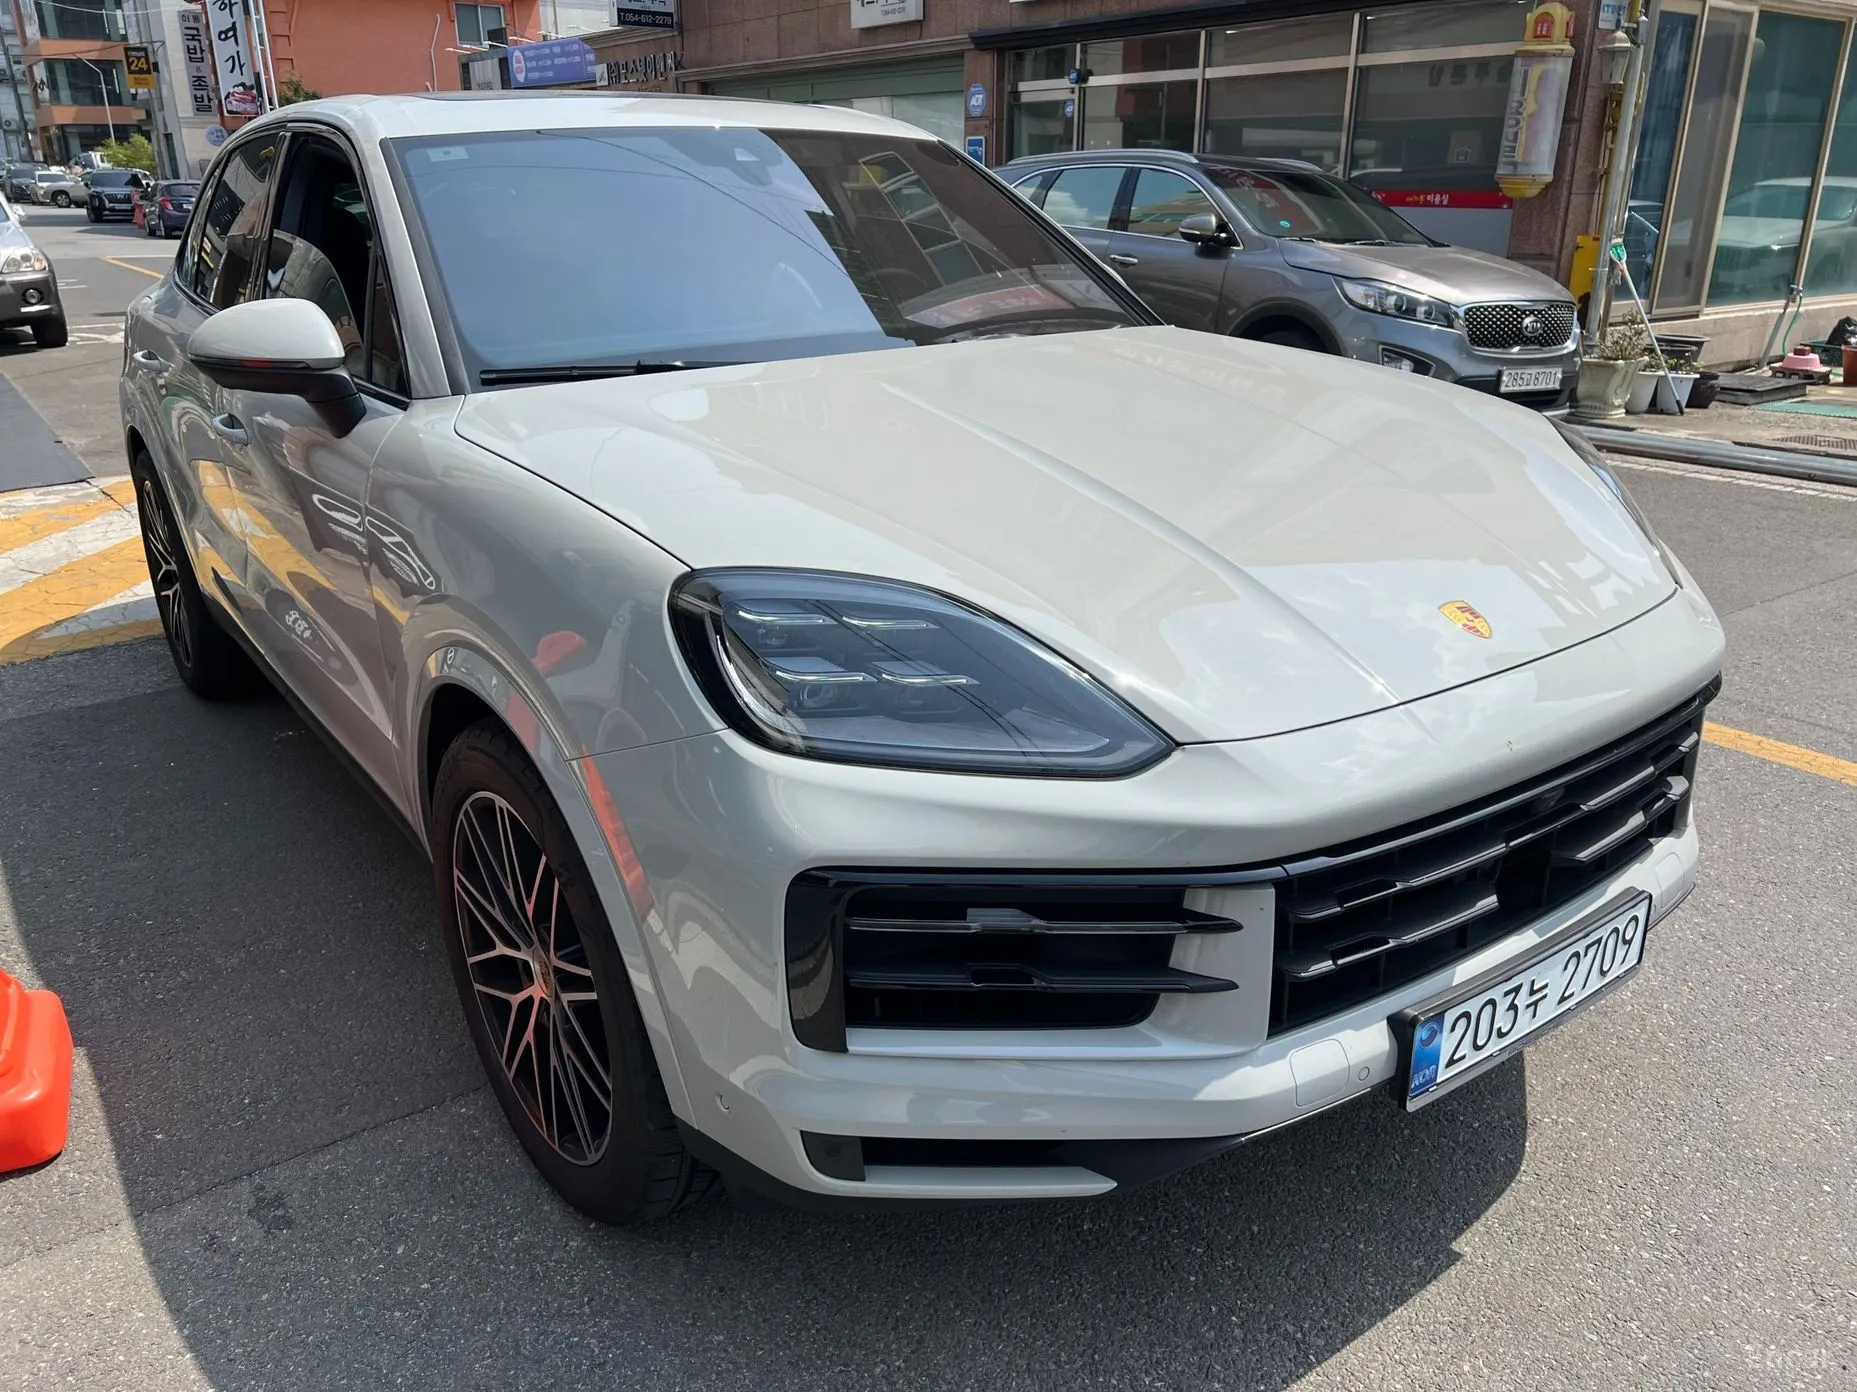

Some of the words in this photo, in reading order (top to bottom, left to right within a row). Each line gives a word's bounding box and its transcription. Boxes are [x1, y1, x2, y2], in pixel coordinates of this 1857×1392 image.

[619, 12, 672, 25] T.054-612-2279
[183, 26, 206, 64] 국밥
[129, 57, 149, 71] 24
[191, 75, 214, 113] 족발
[969, 94, 984, 106] ADT
